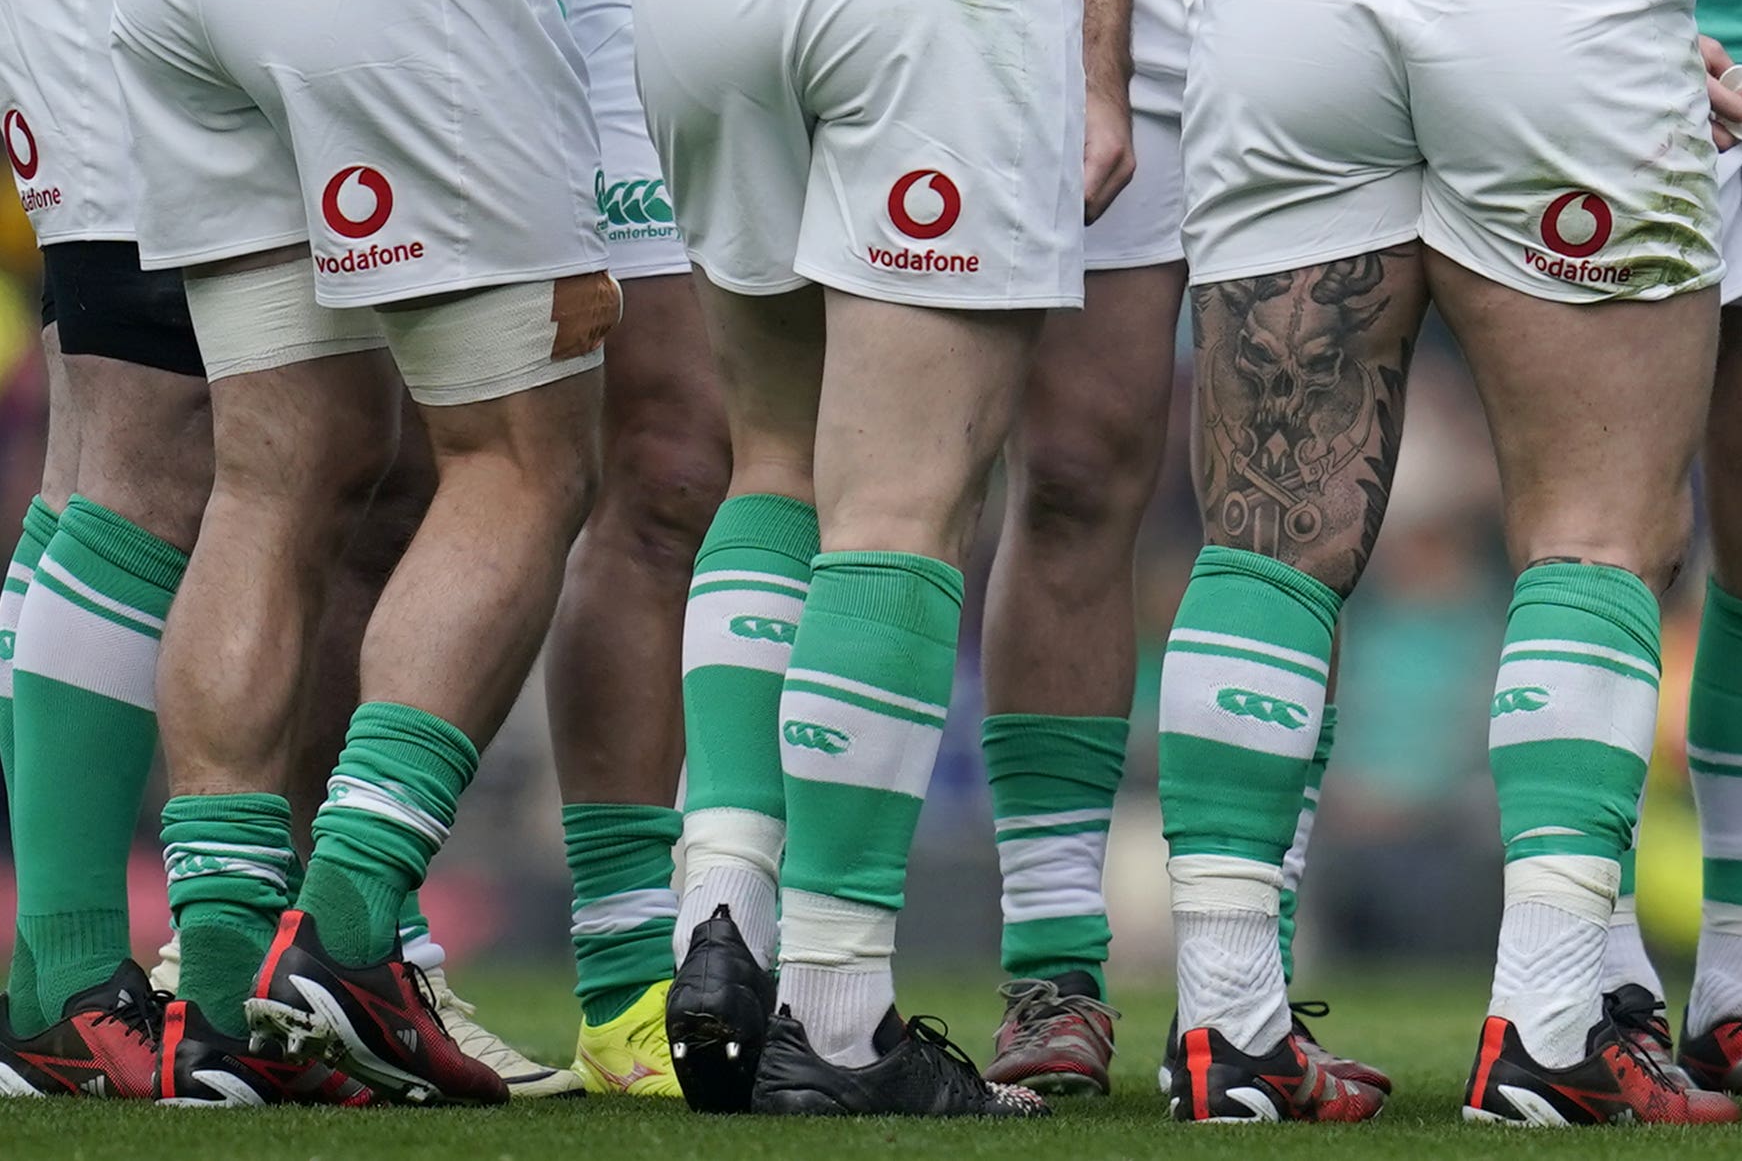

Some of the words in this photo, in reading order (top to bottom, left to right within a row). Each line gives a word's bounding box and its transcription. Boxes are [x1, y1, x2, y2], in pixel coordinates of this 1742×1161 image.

[608, 225, 683, 241] anterbury
[315, 241, 425, 274] vodafone
[867, 245, 980, 273] vodafone
[1523, 247, 1632, 284] vodafone
